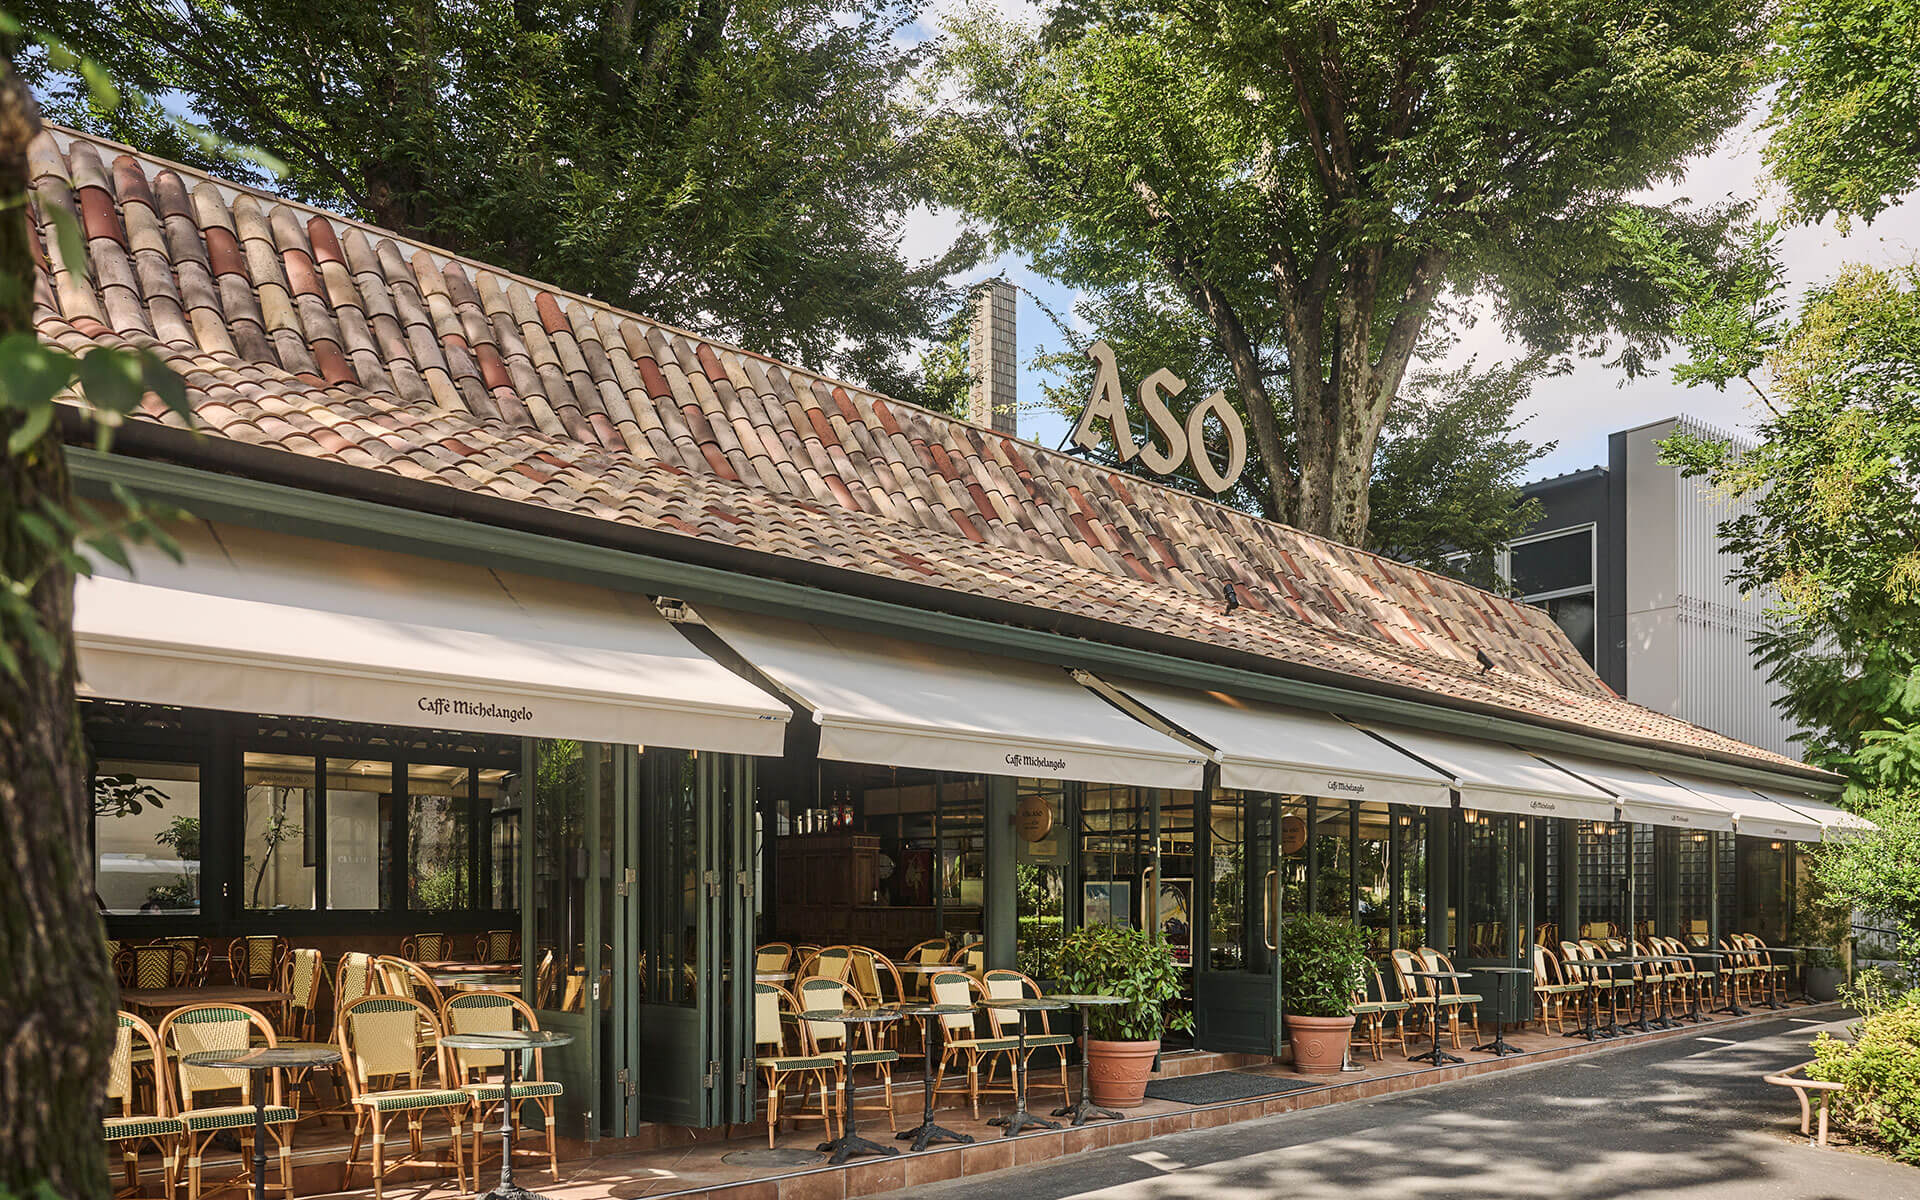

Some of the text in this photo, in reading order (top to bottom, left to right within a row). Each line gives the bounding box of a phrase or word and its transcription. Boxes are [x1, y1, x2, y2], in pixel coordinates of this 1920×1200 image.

[1069, 340, 1247, 493] ASO
[418, 697, 533, 723] Caffè Michelangelo
[1023, 755, 1066, 771] Michelangelo
